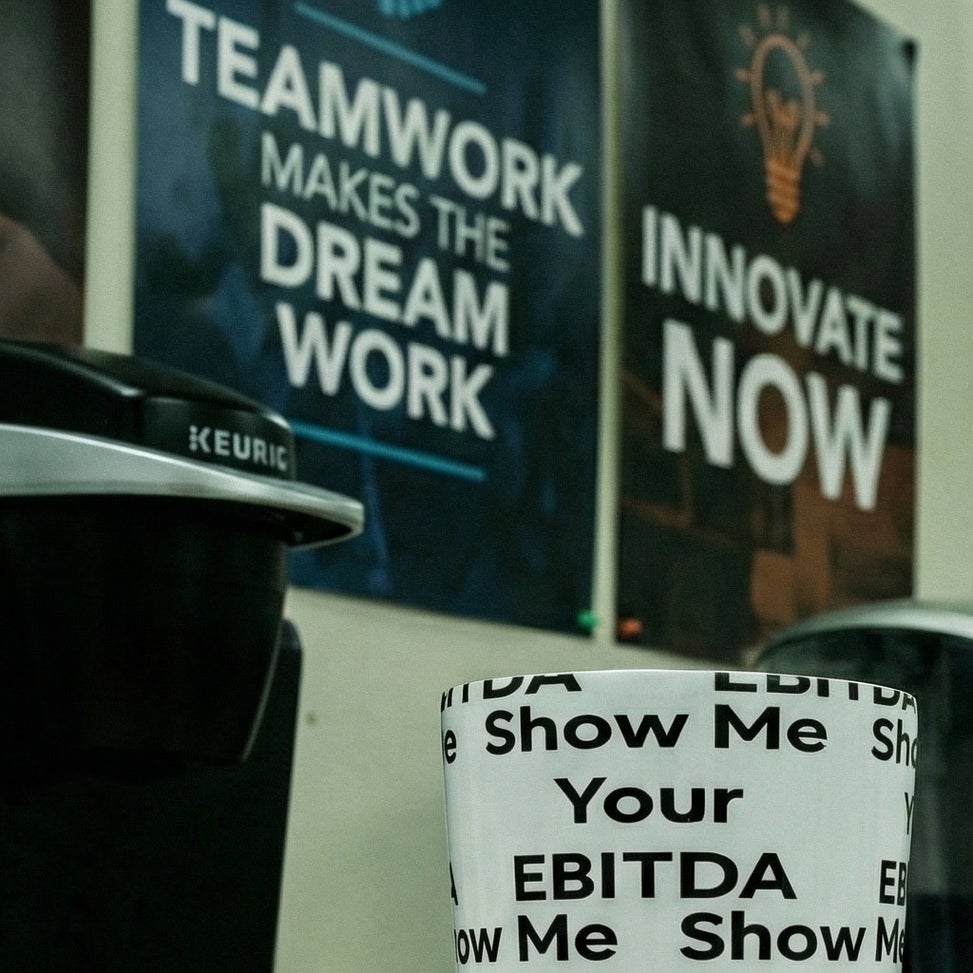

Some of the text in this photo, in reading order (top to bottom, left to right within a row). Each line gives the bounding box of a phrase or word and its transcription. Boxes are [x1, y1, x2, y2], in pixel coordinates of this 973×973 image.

[166, 0, 584, 237] TEAMWORK
[260, 131, 510, 273] MAKES THE
[260, 202, 509, 357] DREAM
[641, 204, 904, 384] INNOVATE
[275, 302, 495, 440] WORK
[662, 318, 892, 513] NOW
[486, 706, 689, 755] Show
[715, 704, 827, 752] Me
[554, 777, 743, 823] Your
[454, 927, 502, 965] ow
[518, 914, 617, 961] Me
[680, 911, 866, 961] Show
[514, 852, 797, 901] EBITDA
